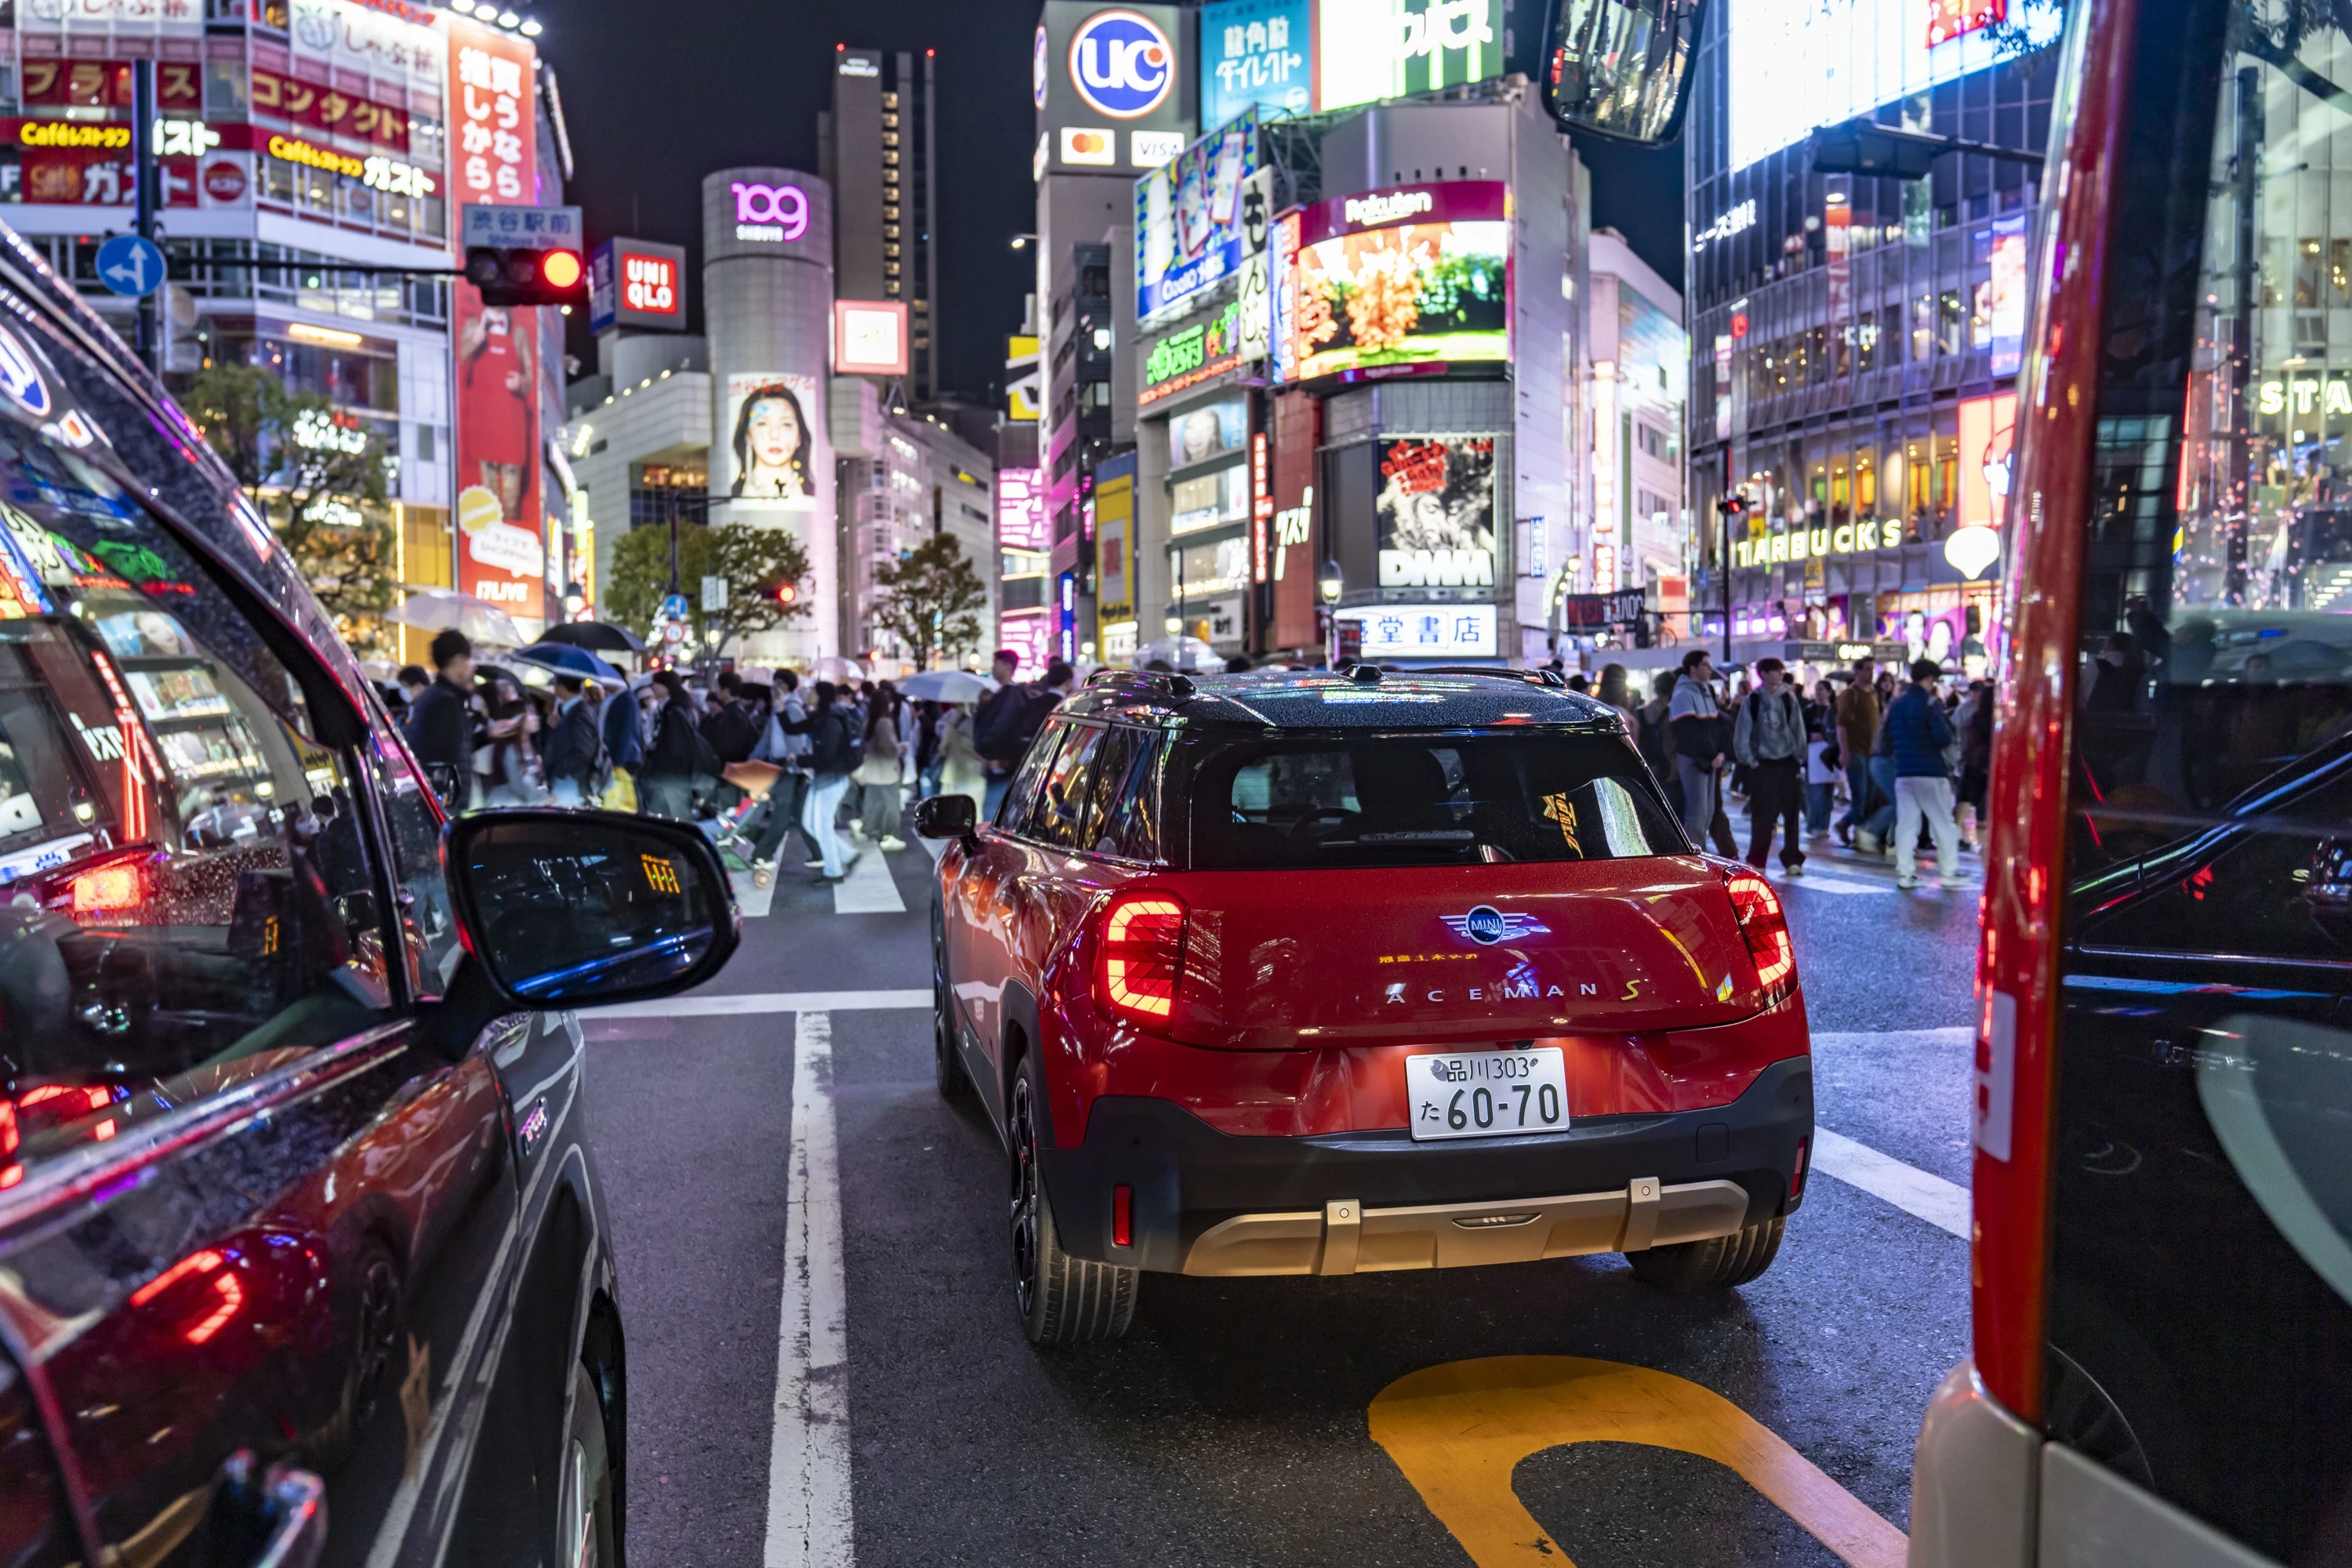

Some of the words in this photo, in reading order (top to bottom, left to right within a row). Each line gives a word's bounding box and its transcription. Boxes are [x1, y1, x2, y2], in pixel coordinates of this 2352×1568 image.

[1081, 38, 1166, 93] UC
[252, 72, 405, 140] コンタクト
[1139, 142, 1181, 158] VISA
[363, 155, 435, 199] ガスト
[472, 209, 572, 234] 渋谷駅前
[731, 181, 810, 241] 109
[1345, 191, 1432, 223] Rakuten
[626, 259, 669, 286] UNI
[626, 283, 673, 309] QLO
[2259, 380, 2352, 415] STA
[1737, 518, 1902, 568] TARBUCKS
[1378, 549, 1494, 586] DMM
[475, 579, 529, 603] 17LIVE
[1470, 918, 1502, 931] MINI
[1385, 983, 1597, 1004] ACEMAN
[1447, 1083, 1560, 1131] 60-70
